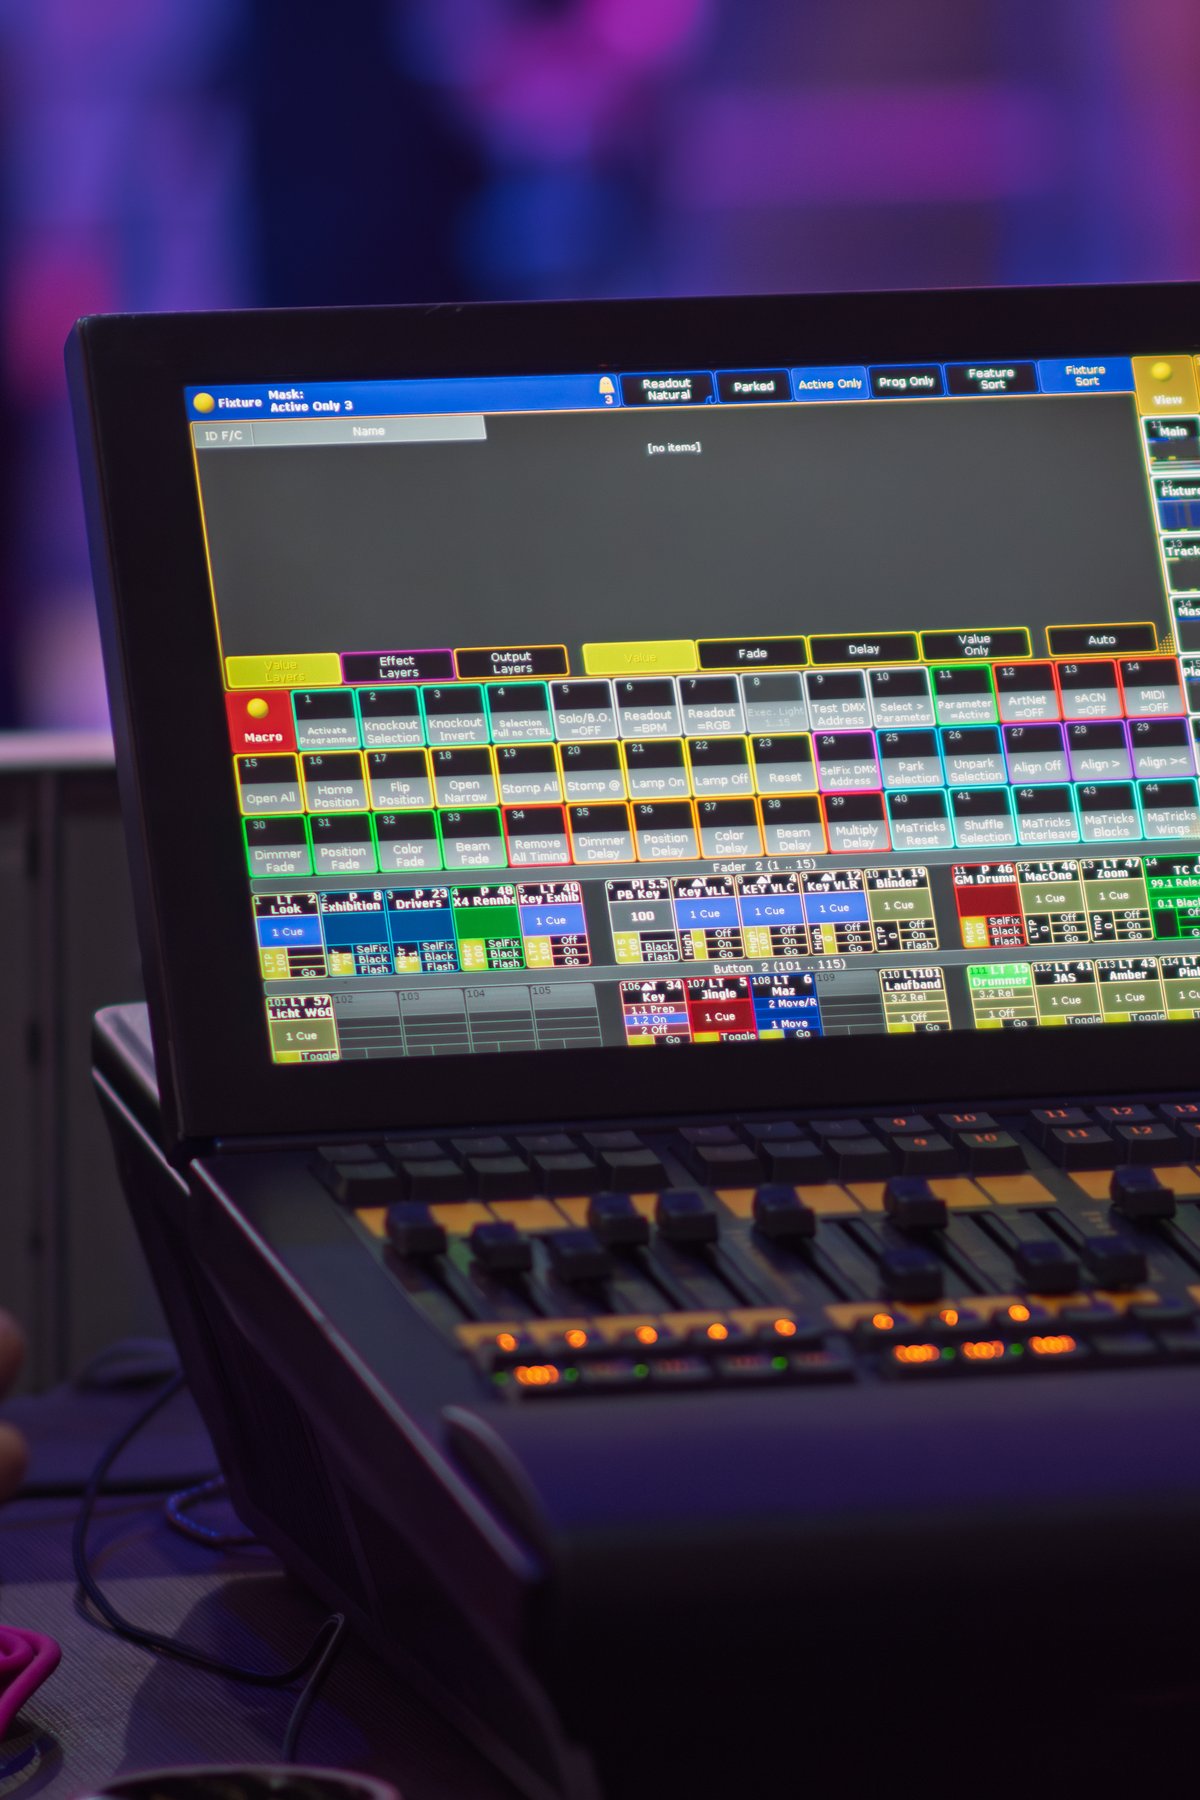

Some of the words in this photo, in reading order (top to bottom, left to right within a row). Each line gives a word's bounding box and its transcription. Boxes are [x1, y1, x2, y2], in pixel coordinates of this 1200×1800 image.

[968, 366, 1015, 380] Feature
[1065, 364, 1106, 376] Fixture
[643, 377, 692, 390] Readout
[734, 381, 774, 393] Parked
[798, 379, 835, 390] Active
[837, 377, 862, 390] Only
[879, 376, 905, 390] Prog
[907, 375, 934, 389] Only
[981, 379, 1006, 390] Sort
[1075, 375, 1100, 387] Sort
[268, 389, 304, 400] Mask:
[647, 389, 691, 401] Natural
[1153, 394, 1183, 406] View
[218, 397, 262, 409] Fixture
[270, 401, 309, 413] Active
[312, 400, 340, 413] Only
[344, 400, 353, 410] 3
[205, 431, 217, 441] ID
[221, 430, 242, 441] F/C
[352, 426, 385, 437] Name
[1159, 426, 1188, 438] Main
[647, 442, 665, 454] [no
[667, 441, 701, 453] items]
[958, 633, 991, 645] Value
[1088, 634, 1116, 645] Auto
[738, 647, 768, 659] Fade
[848, 644, 879, 656] Delay
[964, 645, 989, 658] Only
[379, 655, 415, 666] Effect
[491, 651, 531, 665] Output
[379, 667, 419, 680] Layers
[493, 663, 533, 675] Layers
[1008, 695, 1047, 706] ArtNet
[1074, 692, 1106, 703] sACN
[1140, 690, 1165, 701] MIDI
[811, 703, 837, 714] Test
[842, 702, 866, 713] DMX
[880, 701, 913, 712] Select
[938, 699, 992, 711] Parameter
[558, 712, 612, 724] Solo/B.O.
[624, 710, 672, 722] Readout
[688, 707, 736, 719] Readout
[877, 712, 931, 724] Parameter
[1014, 707, 1044, 718] =OFF
[364, 719, 418, 732] Knockout
[428, 717, 482, 729] Knockout
[696, 719, 731, 731] =RGB
[816, 714, 864, 726] Address
[307, 726, 347, 736] Activate
[570, 725, 601, 736] =OFF
[633, 722, 667, 733] =BPM
[244, 732, 283, 743] Macro
[300, 735, 356, 746] Programmer
[367, 732, 421, 744] Selection
[439, 730, 476, 742] Invert
[898, 760, 924, 772] Park
[954, 757, 994, 770] Unpark
[1014, 762, 1043, 775] Align
[1045, 760, 1062, 772] Off
[632, 778, 666, 790] Lamp
[668, 777, 685, 787] On
[769, 772, 802, 783] Reset
[317, 784, 353, 796] Home
[390, 781, 410, 794] Flip
[449, 779, 480, 792] Open
[247, 794, 277, 806] Open
[280, 792, 296, 803] All
[314, 796, 359, 808] Position
[444, 791, 487, 803] Narrow
[895, 822, 946, 834] MaTricks
[964, 819, 1004, 831] Shuffle
[1156, 824, 1190, 836] Wings
[1019, 828, 1078, 841] Interleave
[1093, 825, 1130, 838] Blocks
[643, 832, 688, 845] Position
[393, 843, 423, 855] Color
[455, 841, 490, 853] Beam
[254, 848, 302, 860] Dimmer
[713, 861, 746, 873] Fader
[1173, 865, 1190, 875] TC
[1025, 871, 1072, 882] MacOne
[1097, 868, 1128, 879] Zoom
[743, 884, 767, 895] KEY
[771, 883, 795, 893] VLC
[876, 877, 918, 889] Blinder
[617, 889, 633, 900] PB
[638, 888, 660, 900] Key
[271, 904, 302, 915] Look
[321, 900, 381, 913] Exhibition
[396, 898, 442, 910] Drivers
[713, 962, 754, 974] Button
[1053, 973, 1076, 983] JAS
[1109, 970, 1147, 981] Amber
[885, 978, 941, 991] Laufband
[701, 988, 737, 1000] Jingle
[771, 986, 796, 996] Maz
[269, 1007, 301, 1019] Licht
